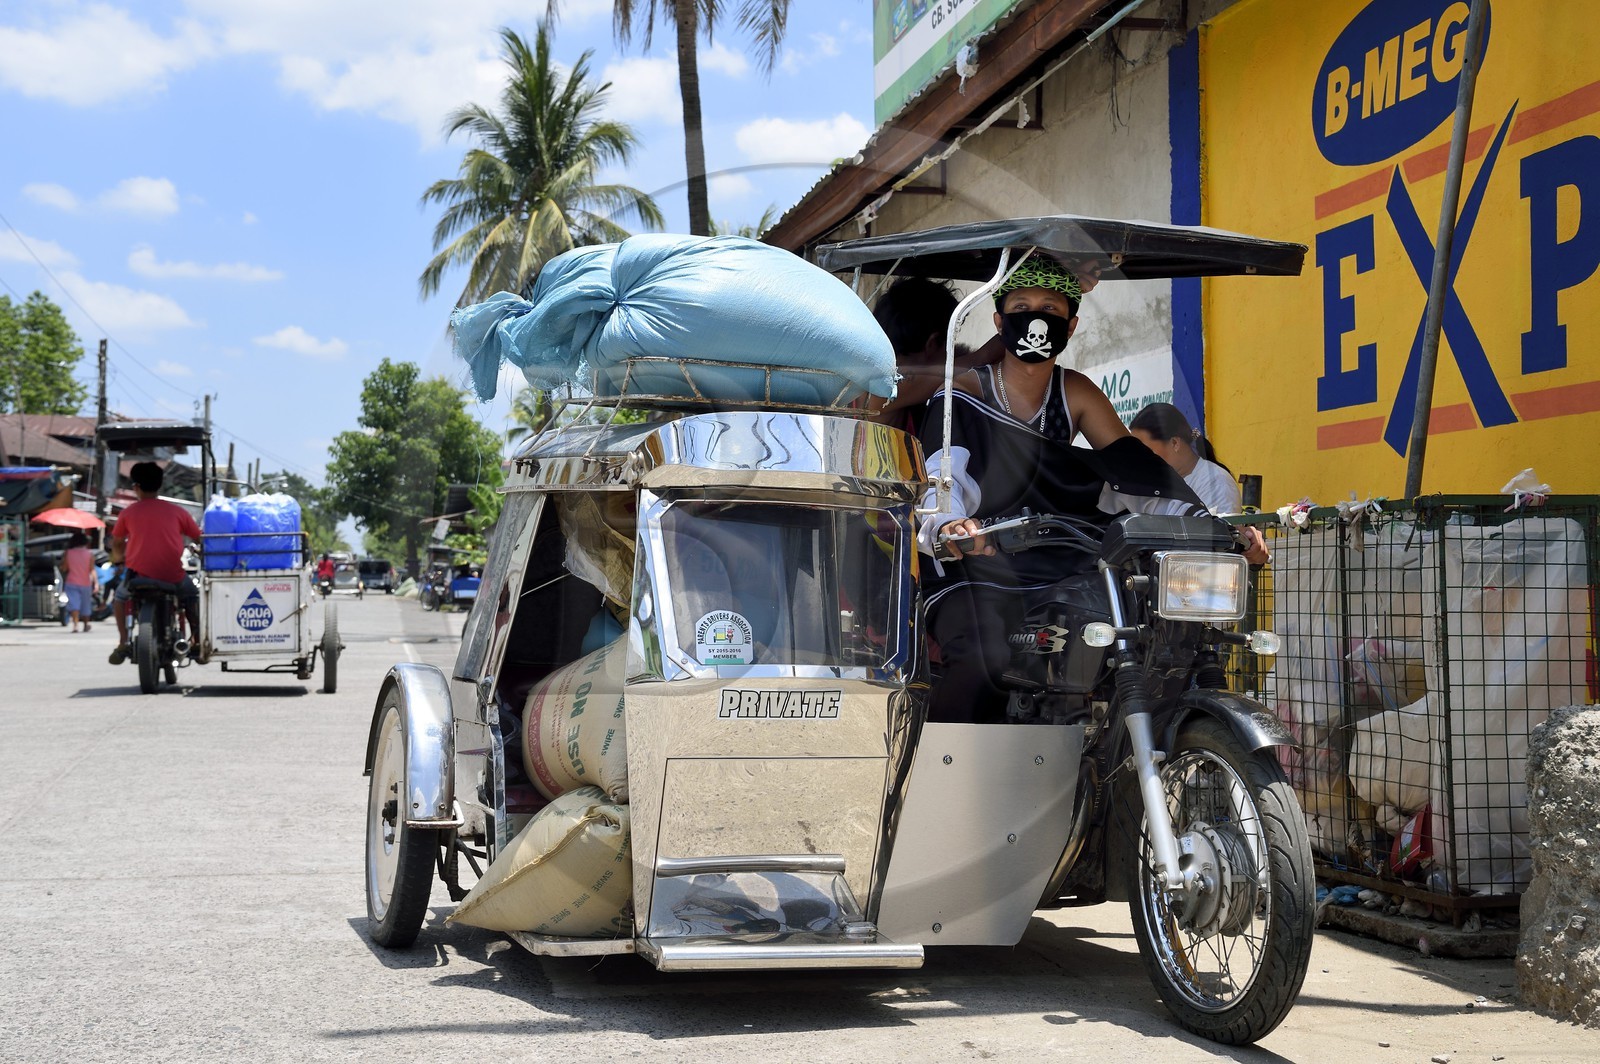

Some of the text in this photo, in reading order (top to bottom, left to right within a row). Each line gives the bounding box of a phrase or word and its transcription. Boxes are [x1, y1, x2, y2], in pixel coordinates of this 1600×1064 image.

[931, 5, 945, 29] CB.
[1324, 2, 1470, 138] B-MEG
[238, 607, 272, 619] AQUA
[240, 618, 270, 628] time
[697, 612, 752, 645] PARENTS DRIVERS ASSOCIATION
[1009, 633, 1036, 644] AKO
[570, 681, 593, 719] NO
[719, 690, 842, 718] PRIVATE
[567, 724, 586, 776] USE
[601, 728, 616, 756] SWIRE
[591, 870, 613, 892] SWIRE
[572, 893, 591, 909] SWIRE
[550, 909, 571, 924] SWIRE
